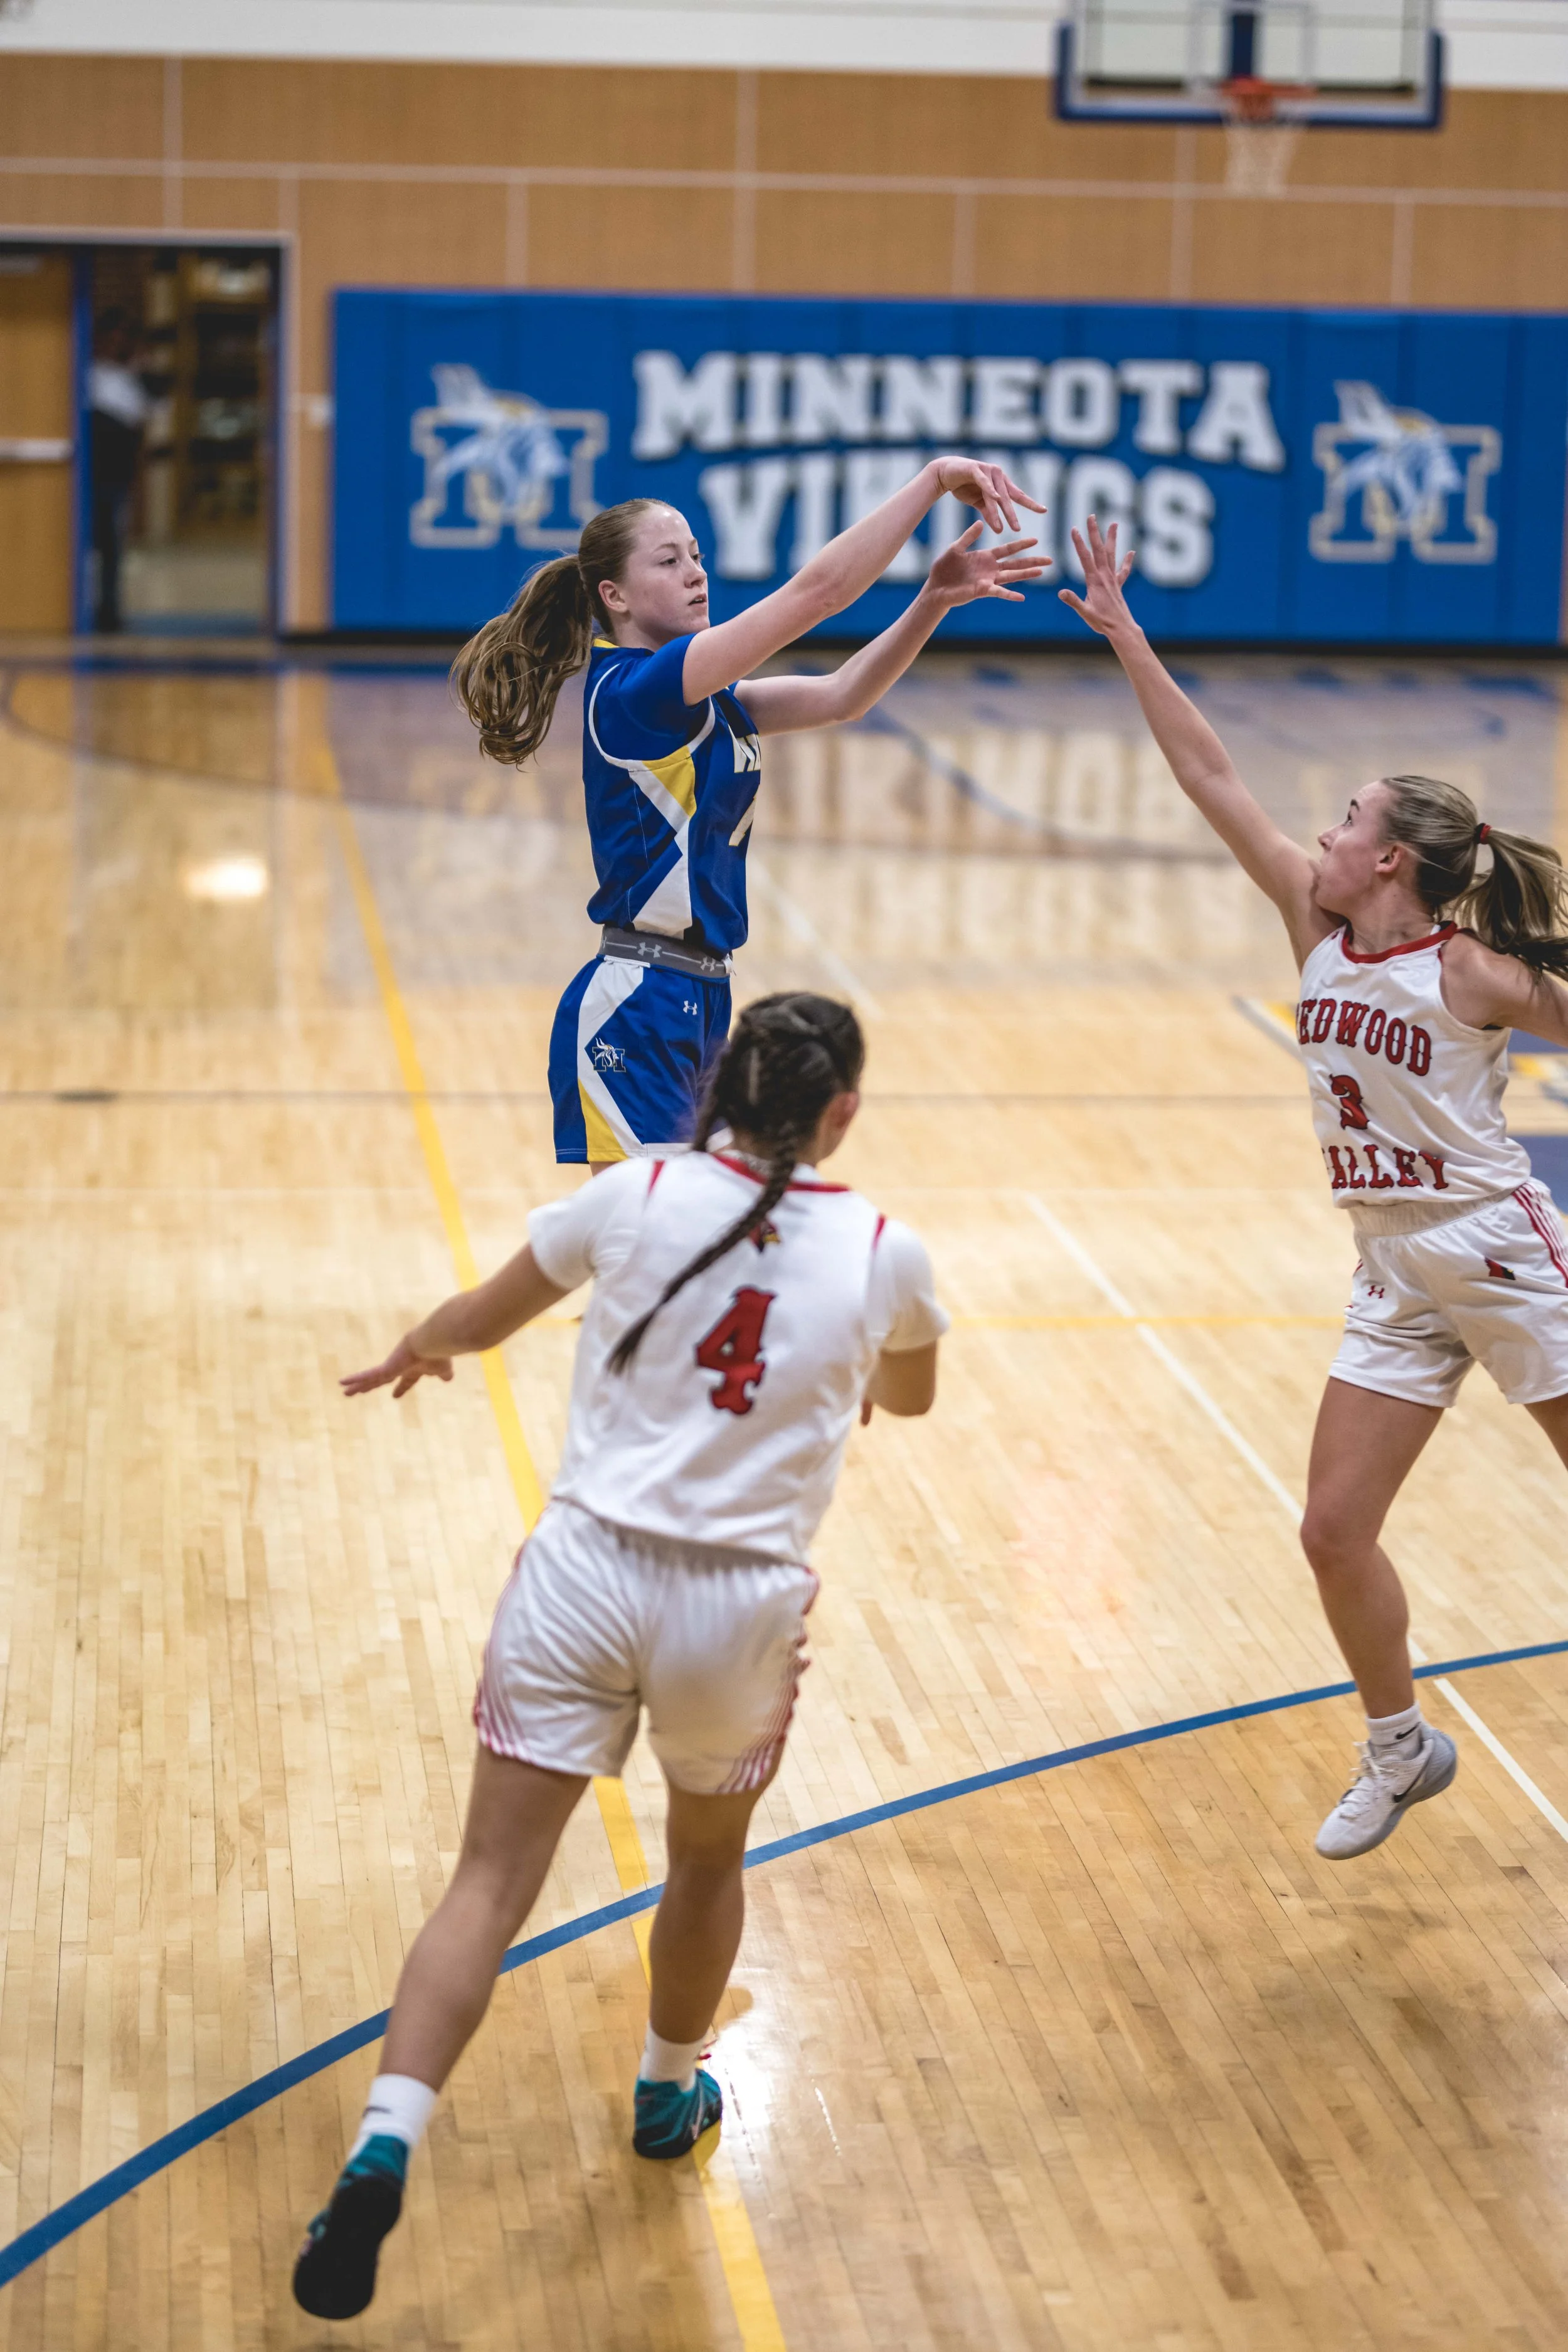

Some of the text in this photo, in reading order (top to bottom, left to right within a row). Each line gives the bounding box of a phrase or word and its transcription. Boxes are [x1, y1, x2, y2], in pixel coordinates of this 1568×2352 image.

[632, 350, 1285, 472] MINNEOTA
[1296, 998, 1432, 1076] EDWOOD
[1322, 1144, 1449, 1190] ALLEY
[694, 1285, 778, 1414] 4
